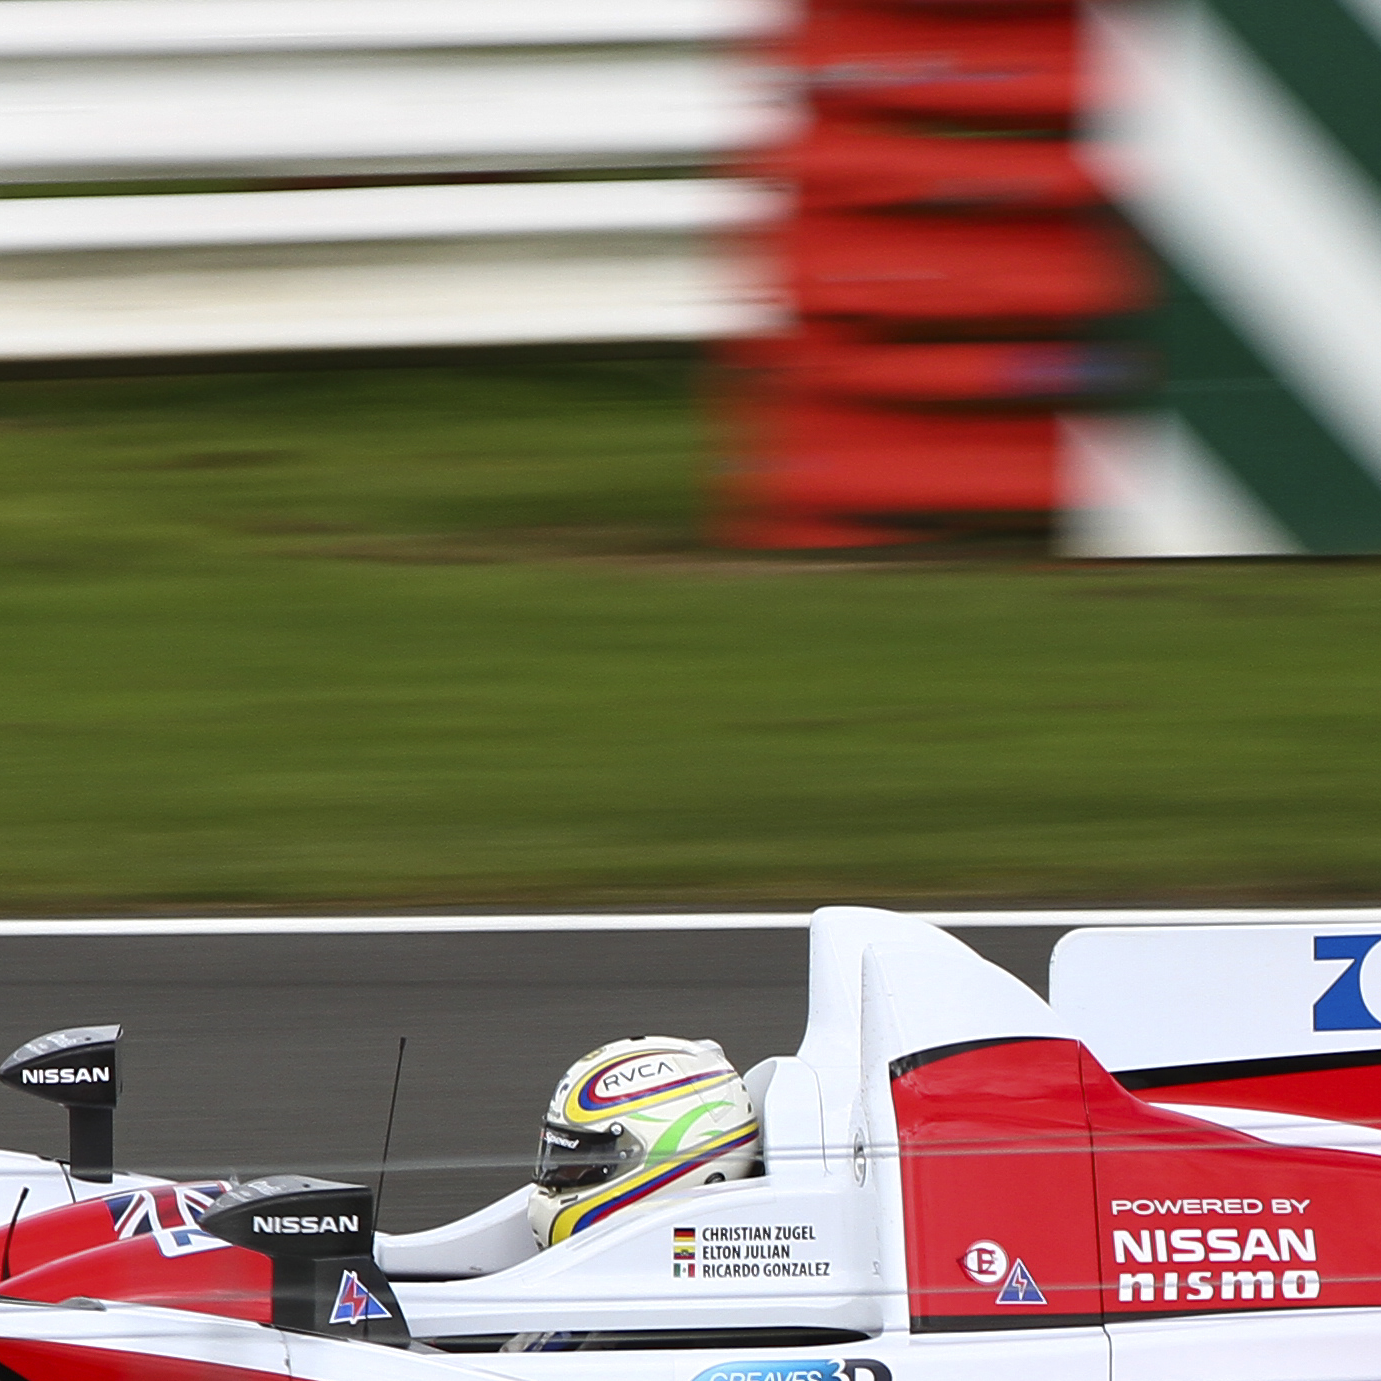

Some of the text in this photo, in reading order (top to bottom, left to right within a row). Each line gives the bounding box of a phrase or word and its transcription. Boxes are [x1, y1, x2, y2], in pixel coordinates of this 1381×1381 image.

[22, 1066, 110, 1084] NISSAN
[1111, 1199, 1311, 1216] POWERED BY
[253, 1215, 359, 1234] NISSAN
[702, 1226, 816, 1241] CHRISTIAN ZUGEL
[702, 1245, 790, 1259] ELTON JULIAN
[1112, 1228, 1317, 1263] NISSAN
[702, 1262, 830, 1278] RICARDO GONZALEZ
[1119, 1270, 1320, 1302] nismo
